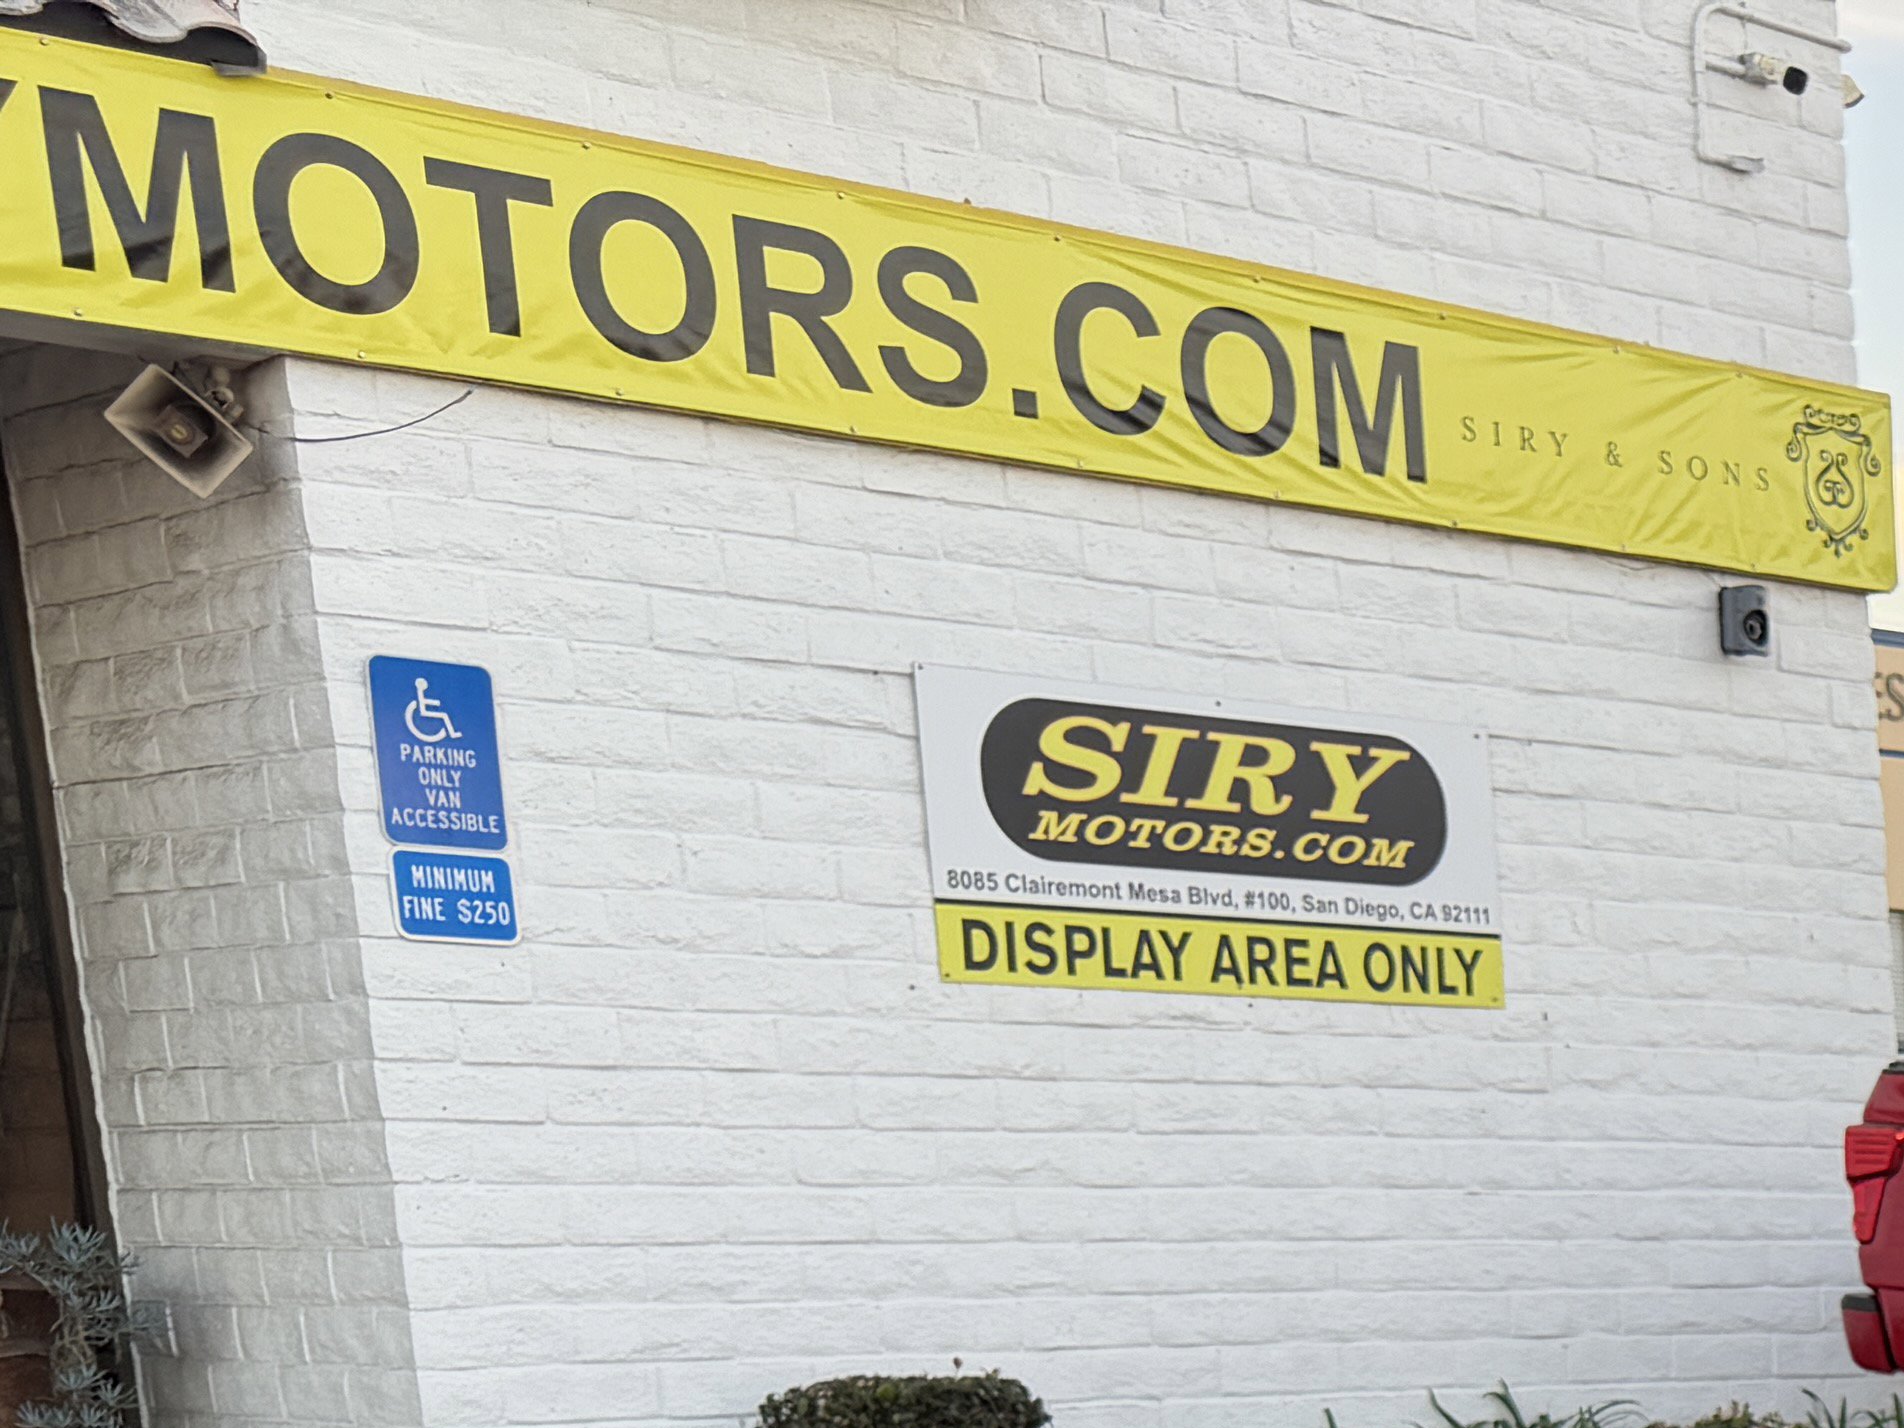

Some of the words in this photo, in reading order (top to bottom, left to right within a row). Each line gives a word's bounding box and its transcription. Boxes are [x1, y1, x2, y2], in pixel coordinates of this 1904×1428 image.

[0, 80, 1428, 484] MOTORS.COM
[1459, 416, 1568, 457] SIRY
[1605, 441, 1623, 467] &
[1657, 450, 1770, 491] SONS
[400, 743, 476, 768] PARKING
[1022, 716, 1410, 823] SIRY
[418, 767, 461, 787] ONLY
[426, 788, 461, 809] VAN
[392, 808, 500, 834] ACCESSIBLE
[1029, 810, 1414, 868] MOTORS.COM
[411, 865, 495, 893] MINIMUM
[947, 869, 999, 891] 8085
[1005, 873, 1122, 900] Clairemont
[1129, 881, 1182, 904] Mesa
[1188, 886, 1238, 910] Blvd,
[1244, 890, 1296, 914] #100,
[1302, 894, 1339, 915] San
[1345, 897, 1404, 921] Diego,
[1410, 901, 1437, 922] CA
[1442, 904, 1490, 924] 92111
[403, 896, 446, 921] FINE
[457, 898, 510, 925] $250
[961, 918, 1192, 982] DISPLAY
[1211, 934, 1348, 990] AREA
[1363, 941, 1483, 996] ONLY
